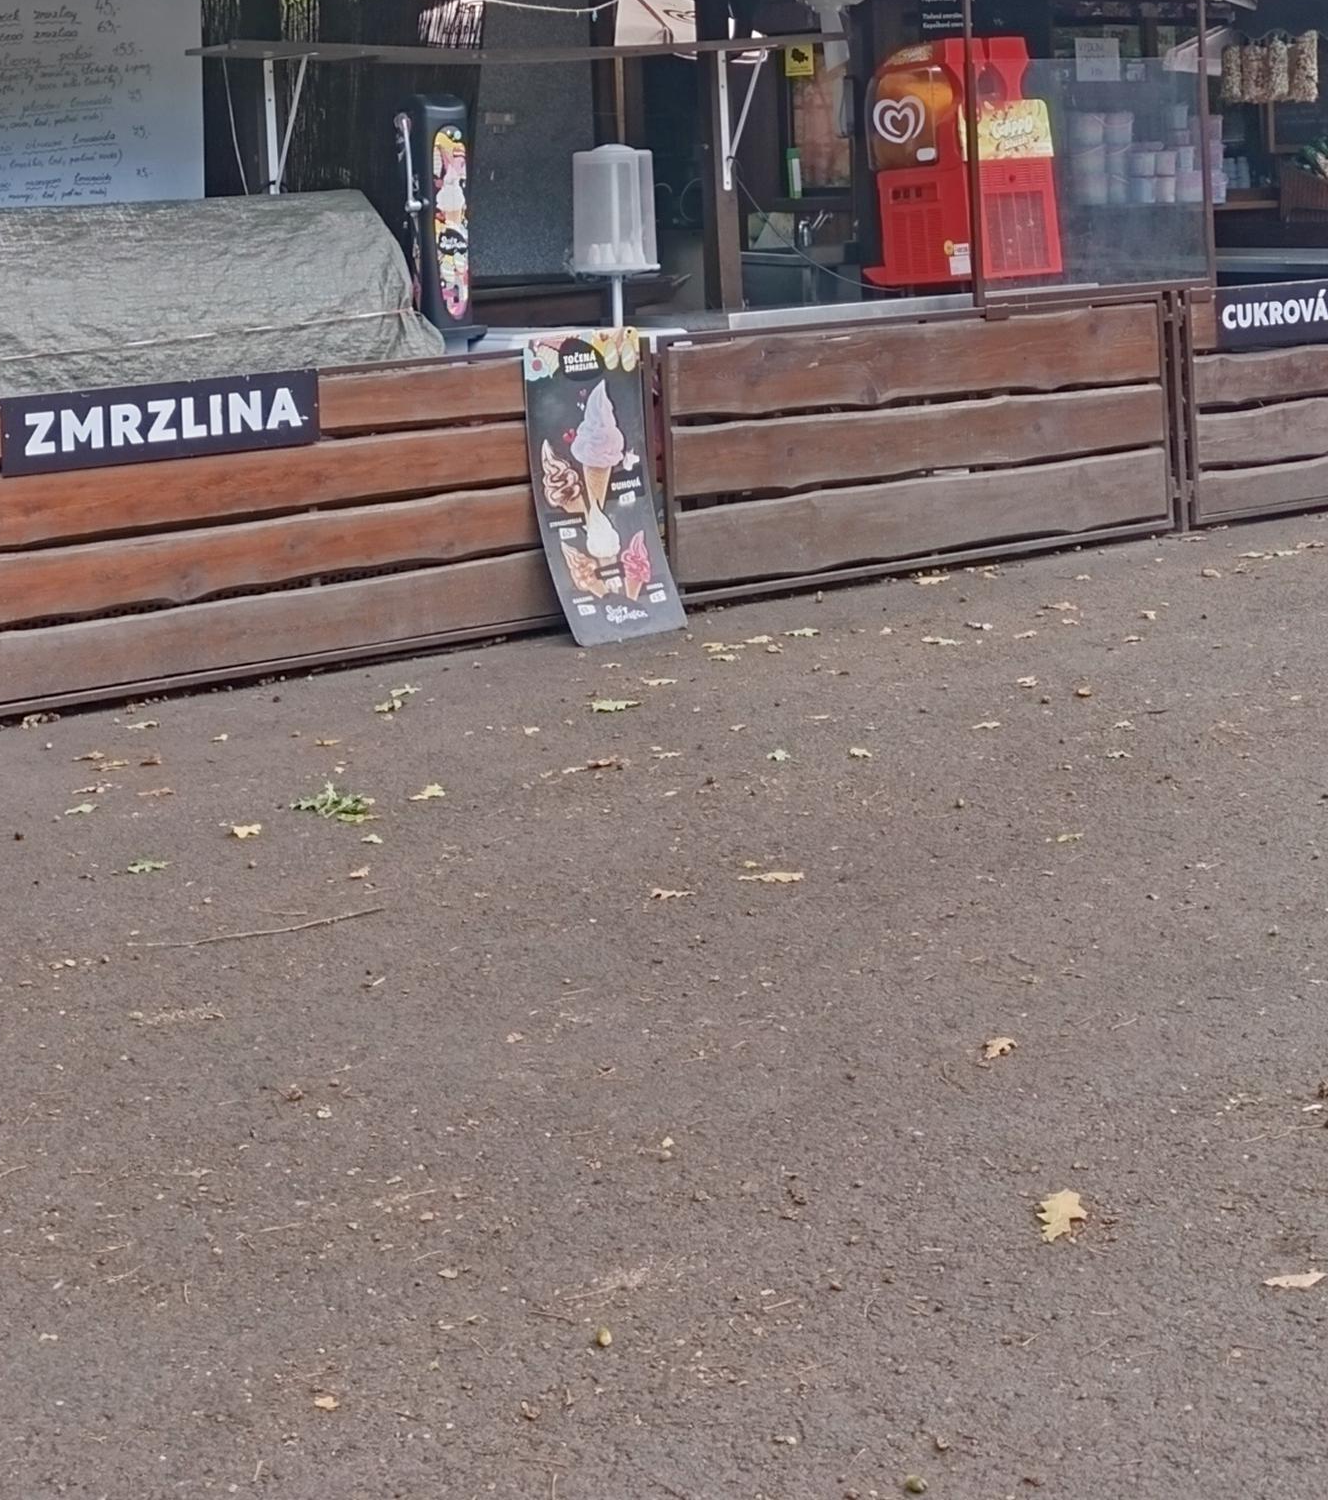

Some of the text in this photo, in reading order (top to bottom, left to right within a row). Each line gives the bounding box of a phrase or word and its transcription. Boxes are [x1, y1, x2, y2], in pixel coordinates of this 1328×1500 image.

[563, 350, 596, 365] TOČENÁ
[565, 361, 599, 373] ZMRZLINA
[24, 387, 303, 456] ZMRZLINA
